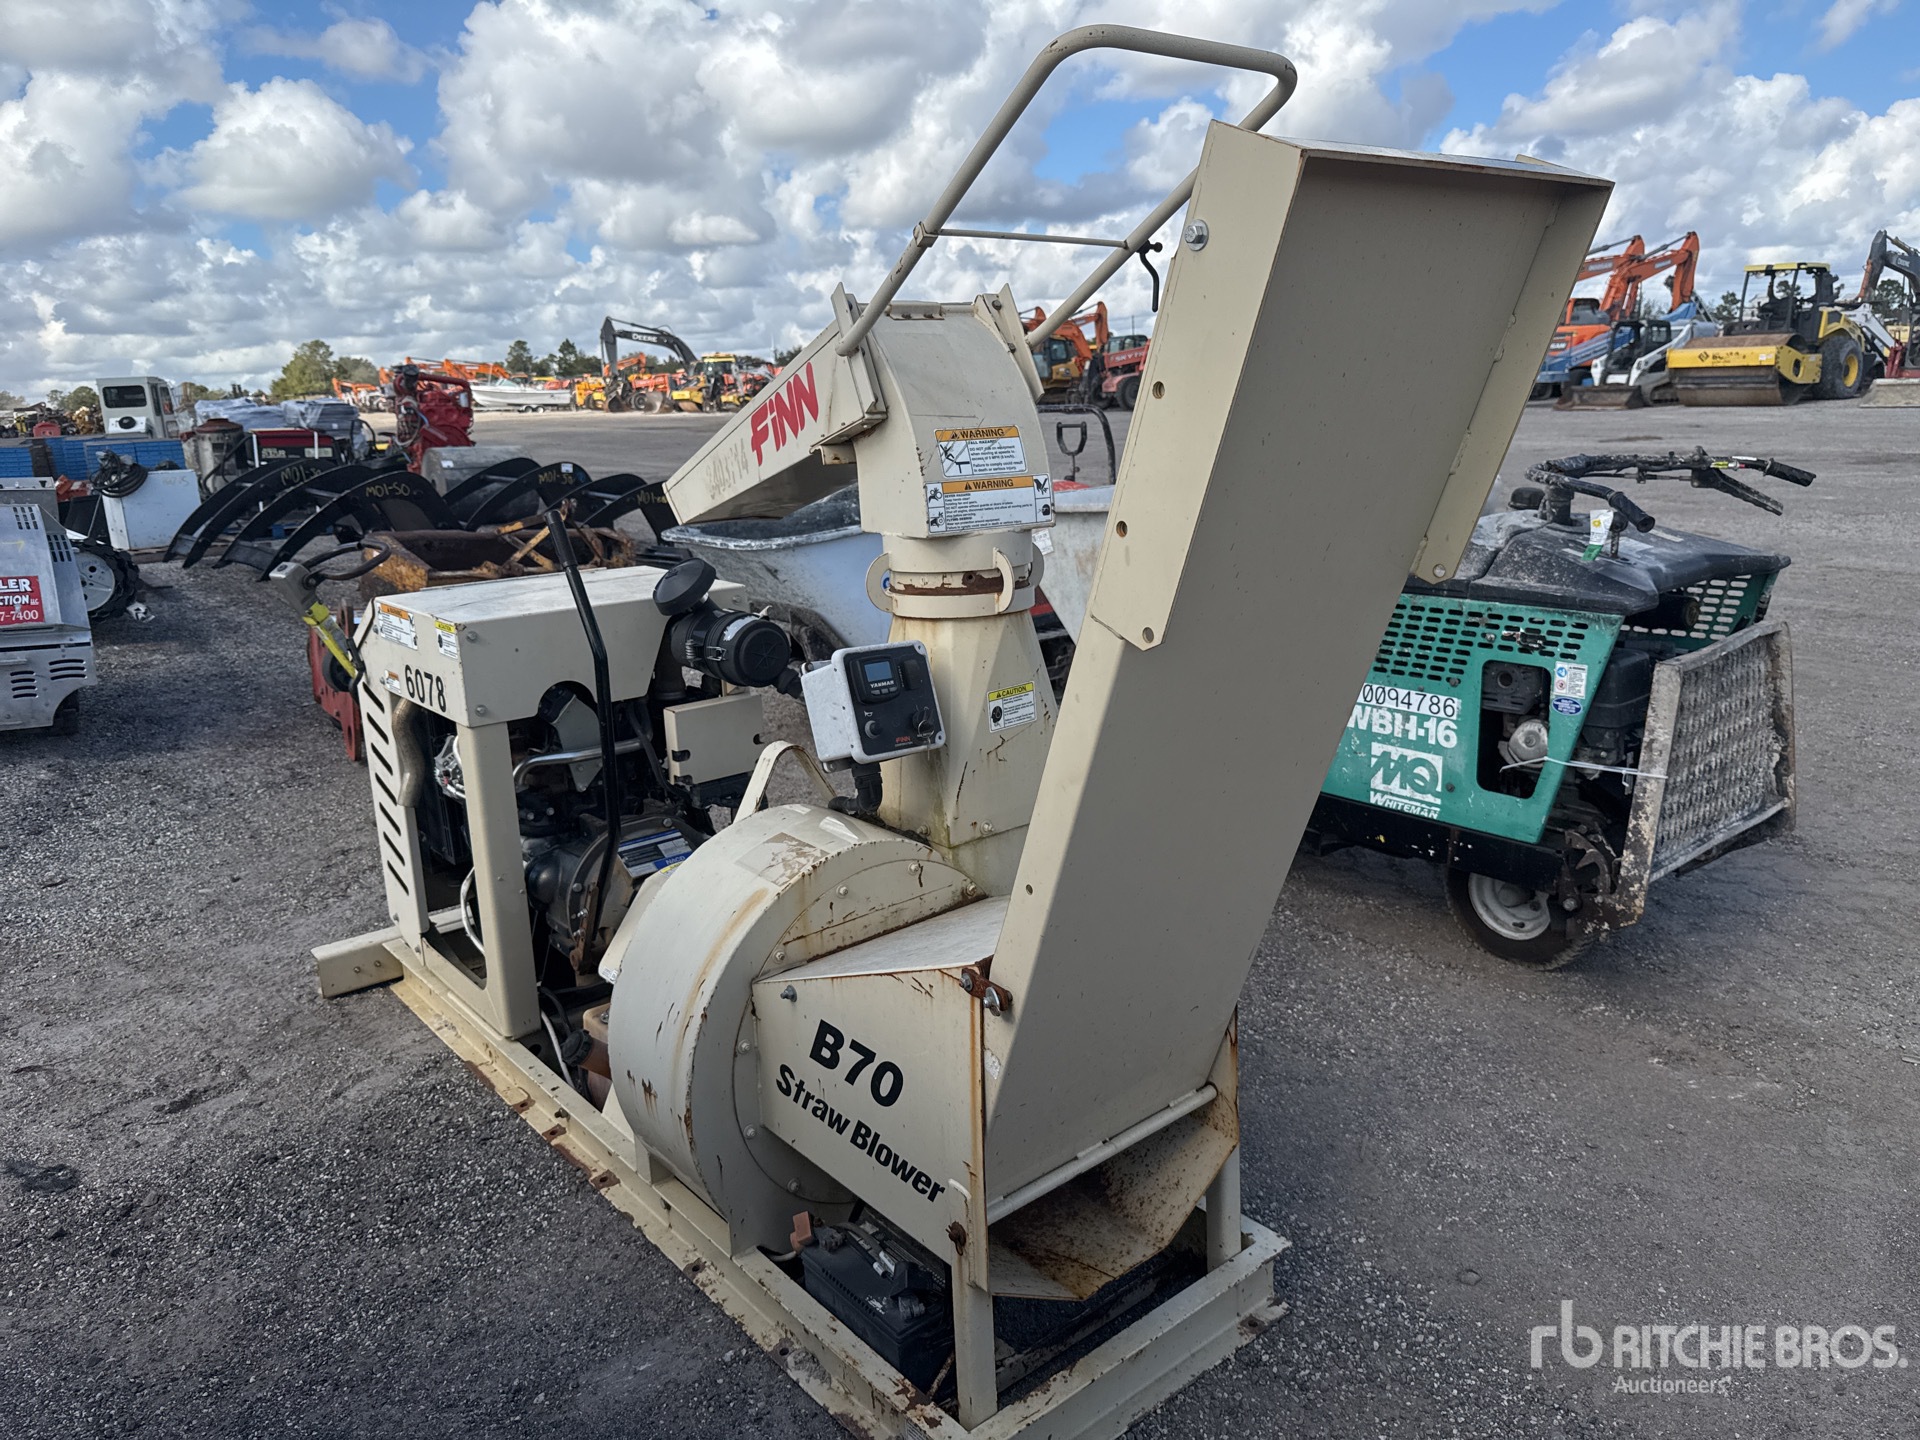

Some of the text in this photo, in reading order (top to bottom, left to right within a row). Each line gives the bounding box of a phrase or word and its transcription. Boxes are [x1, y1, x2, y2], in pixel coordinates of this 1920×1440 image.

[632, 333, 657, 342] DEERE
[751, 361, 819, 467] FINN
[960, 428, 1005, 439] WARNING
[972, 479, 1014, 489] WARNING
[404, 664, 447, 713] 6078
[870, 680, 895, 688] YANMAR
[1001, 686, 1027, 697] CAUTION
[1362, 684, 1455, 717] 0094786
[1369, 791, 1440, 819] WHITEMAN
[809, 1018, 904, 1107] B70
[775, 1063, 946, 1202] Straw Blower
